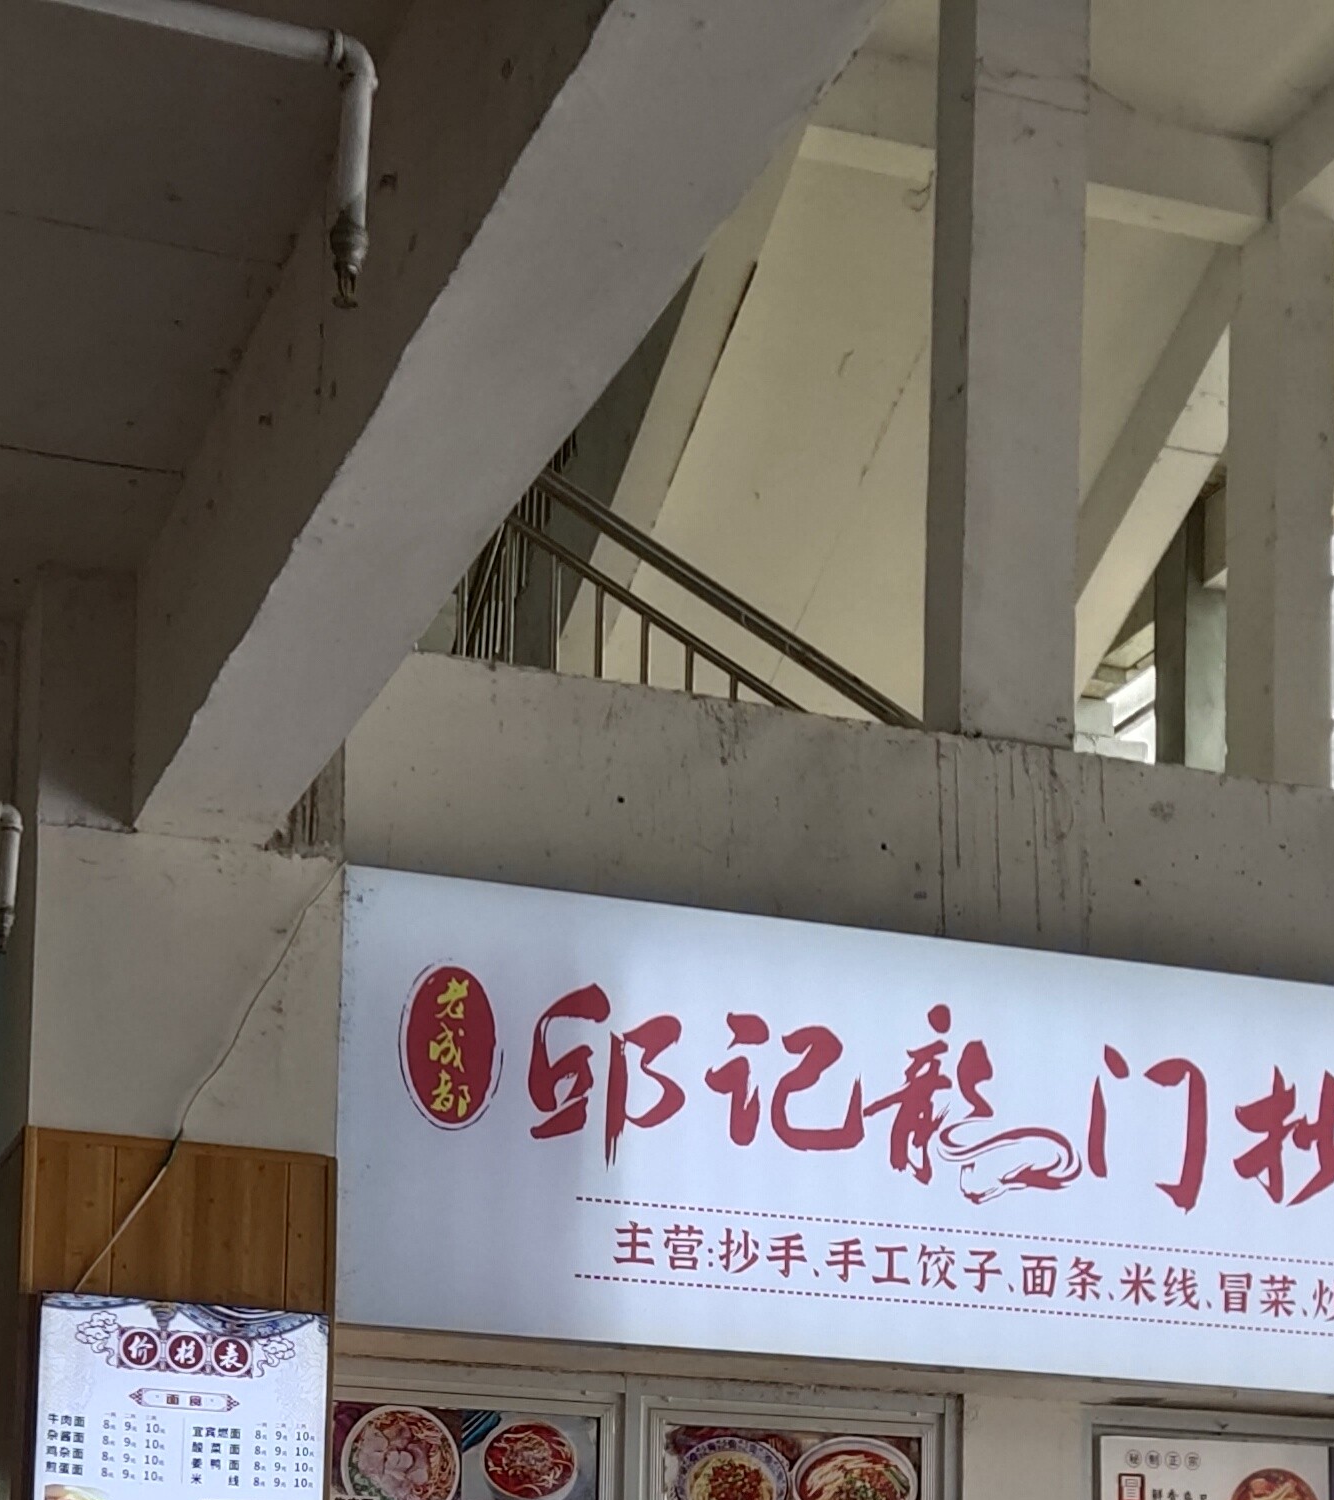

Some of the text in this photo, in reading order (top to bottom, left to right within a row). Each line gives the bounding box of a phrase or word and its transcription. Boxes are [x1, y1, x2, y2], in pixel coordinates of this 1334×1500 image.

[429, 977, 471, 1118] 老成都
[128, 1334, 243, 1369] 价格表
[48, 1413, 85, 1427] 牛肉面
